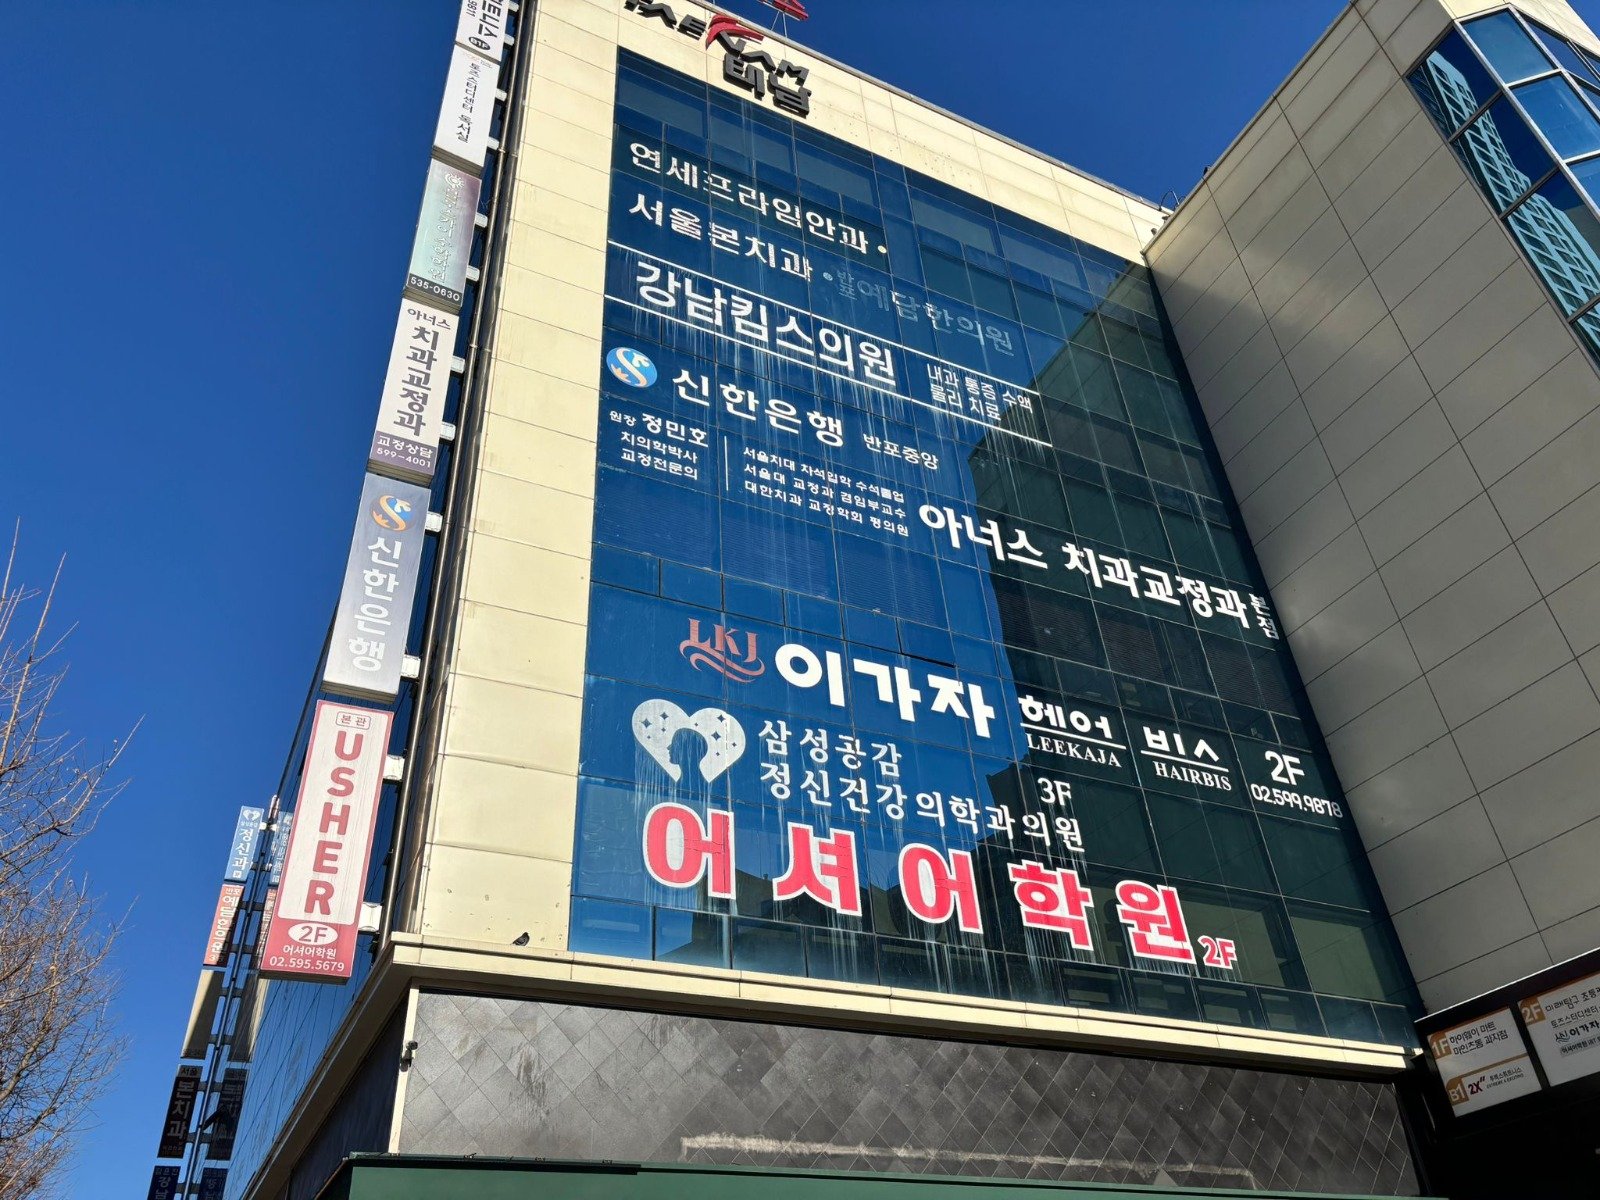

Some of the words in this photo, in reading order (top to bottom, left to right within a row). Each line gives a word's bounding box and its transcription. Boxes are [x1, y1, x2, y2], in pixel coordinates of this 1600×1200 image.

[478, 0, 503, 39] 트니스
[723, 52, 812, 118] 태남
[629, 142, 869, 255] 연세프라임안과
[629, 193, 813, 282] 서울본치과
[410, 276, 460, 301] 535-0630
[407, 308, 451, 330] 아너스
[637, 262, 897, 387] 강남킴스의원
[857, 280, 1014, 356] 예담한의원
[393, 326, 440, 436] 치과교정과
[926, 363, 960, 391] 내과
[1002, 390, 1034, 414] 수액
[673, 368, 844, 448] 신한은행
[863, 433, 938, 470] 반포중앙
[930, 383, 962, 409] 물리
[968, 396, 1002, 421] 치료
[377, 435, 434, 458] 교정상담
[609, 410, 637, 426] 원장
[642, 412, 708, 447] 정민호
[376, 448, 432, 468] 599-4001
[621, 432, 698, 464] 치의학박사
[621, 448, 698, 480] 교정전문의
[743, 447, 796, 471] 서울치대
[743, 463, 786, 485] 서울대
[793, 477, 834, 499] 교정과
[744, 480, 802, 506] 대한치과
[808, 498, 863, 523] 교정학회
[869, 516, 909, 537] 평의원
[919, 503, 1048, 570] 아너스
[1061, 541, 1250, 629] 치과교정과
[348, 537, 403, 673] 신한은행
[1250, 593, 1280, 641] 본점
[687, 618, 758, 664] LKJ
[775, 643, 996, 738] 이가자
[1018, 695, 1113, 741] 헤어
[340, 714, 367, 727] 본관
[758, 720, 903, 778] 삼성공감
[1027, 732, 1122, 768] LEEKAJA
[1154, 761, 1232, 791] HAIRBIS
[1265, 750, 1305, 785] 2F
[760, 763, 1086, 854] 정신건강의학과의원
[1037, 777, 1072, 807] 3F
[1251, 783, 1343, 818] 02.599.9878
[304, 730, 364, 916] USHER
[232, 828, 253, 871] 정신과
[643, 801, 1197, 966] 어셔어학원
[1198, 935, 1238, 970] 2F
[282, 945, 337, 959] 어셔어학원
[298, 925, 328, 943] 2F
[269, 956, 345, 973] 02.595.5679
[1521, 1003, 1543, 1023] 2F
[1545, 994, 1580, 1011] 미래탐구
[1551, 1005, 1598, 1028] 토즈스터디센터
[1480, 1021, 1497, 1033] 마트
[1484, 1029, 1509, 1045] 과자점
[1569, 1020, 1600, 1036] 이가자
[1431, 1039, 1449, 1056] 1F
[1450, 1083, 1465, 1102] B1
